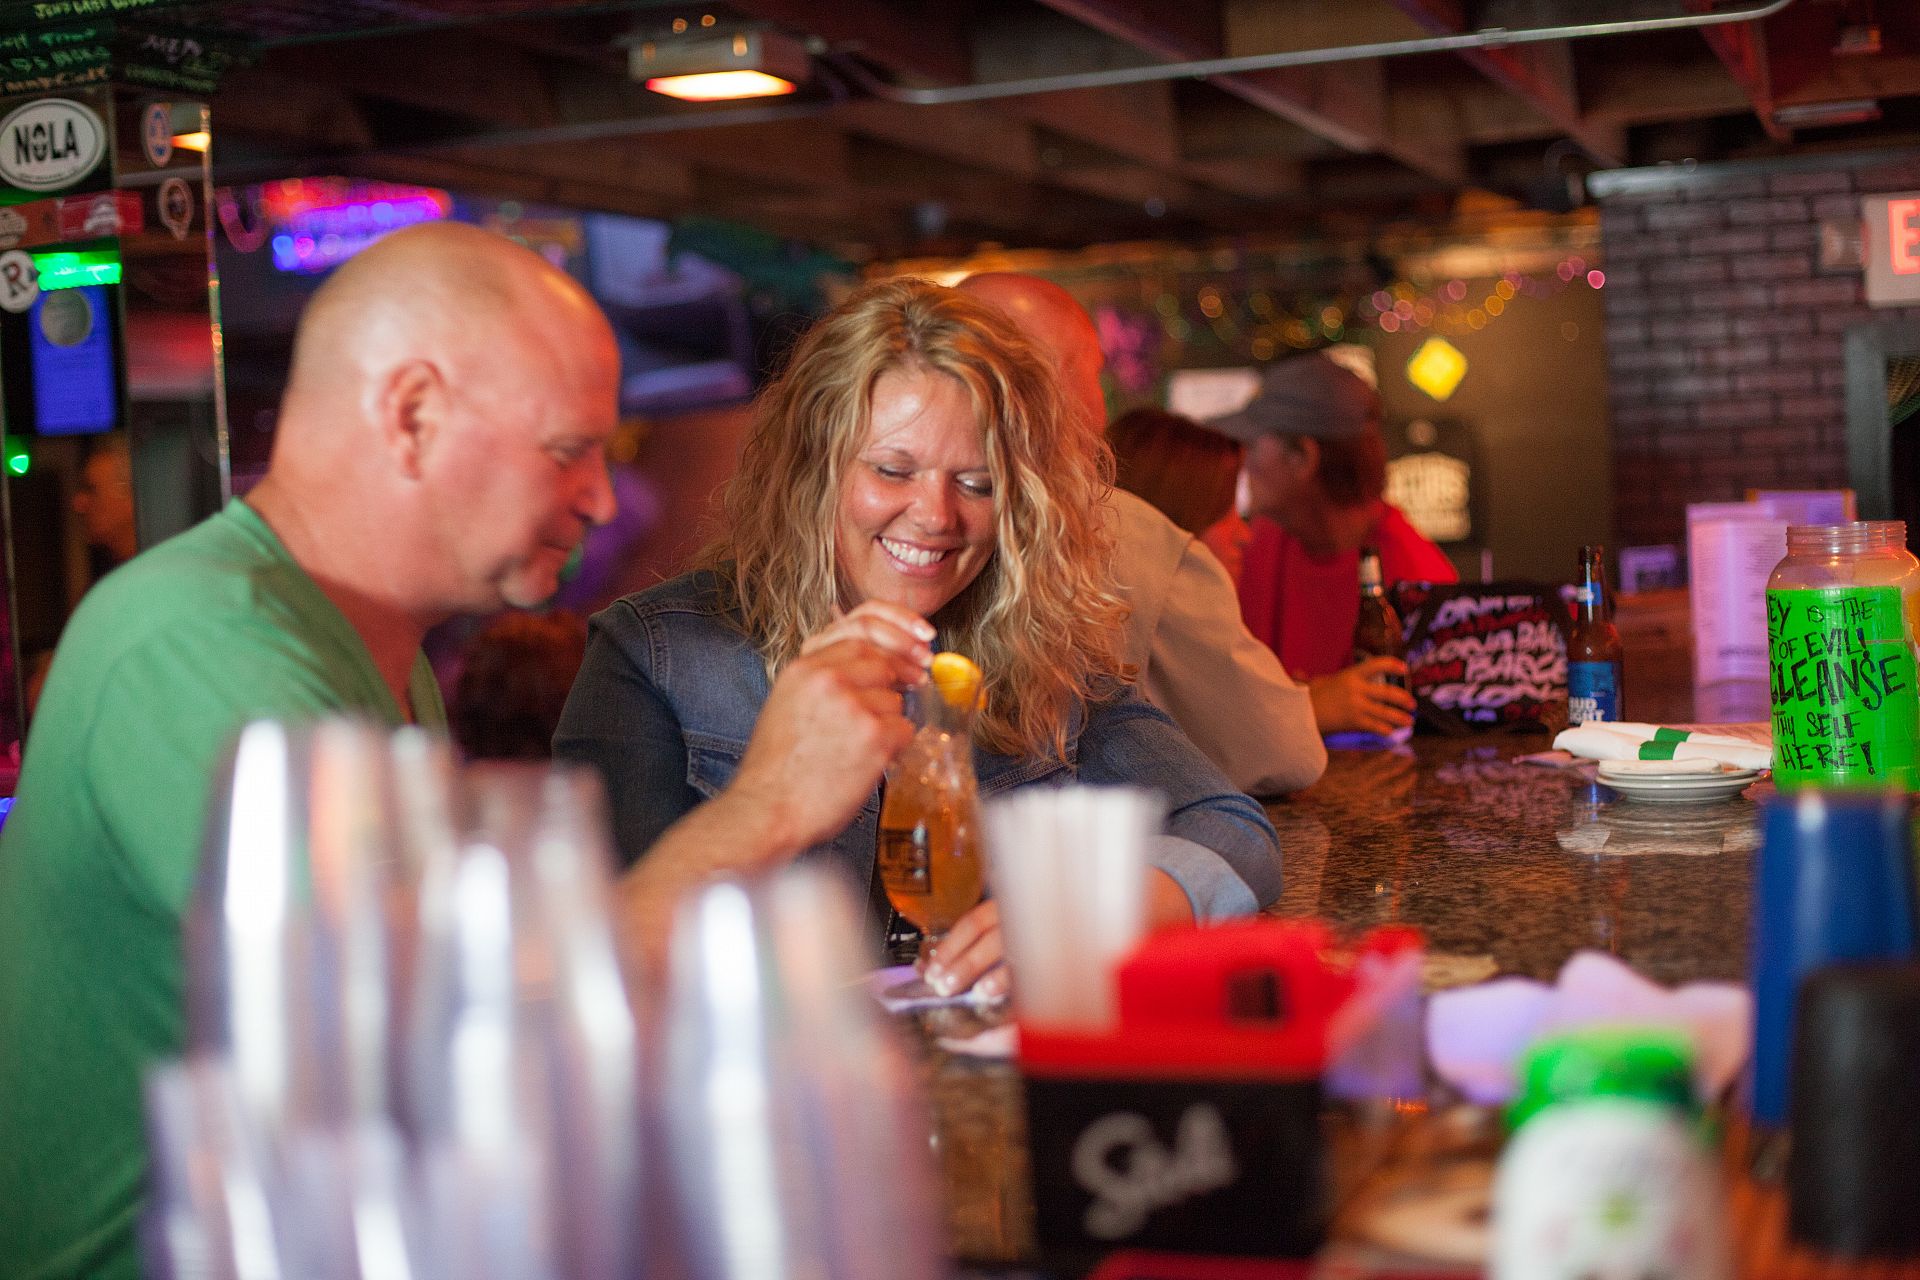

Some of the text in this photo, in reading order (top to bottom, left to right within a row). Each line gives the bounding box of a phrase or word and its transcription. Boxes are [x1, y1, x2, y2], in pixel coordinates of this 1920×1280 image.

[14, 119, 80, 164] NOLA
[1767, 594, 1792, 635] EY
[1834, 597, 1877, 625] THE
[1779, 637, 1798, 660] OF
[1804, 627, 1871, 660] EVIL!
[1770, 654, 1906, 711] CLEANSE
[1807, 710, 1862, 739] SELF
[1780, 741, 1876, 775] HERE!
